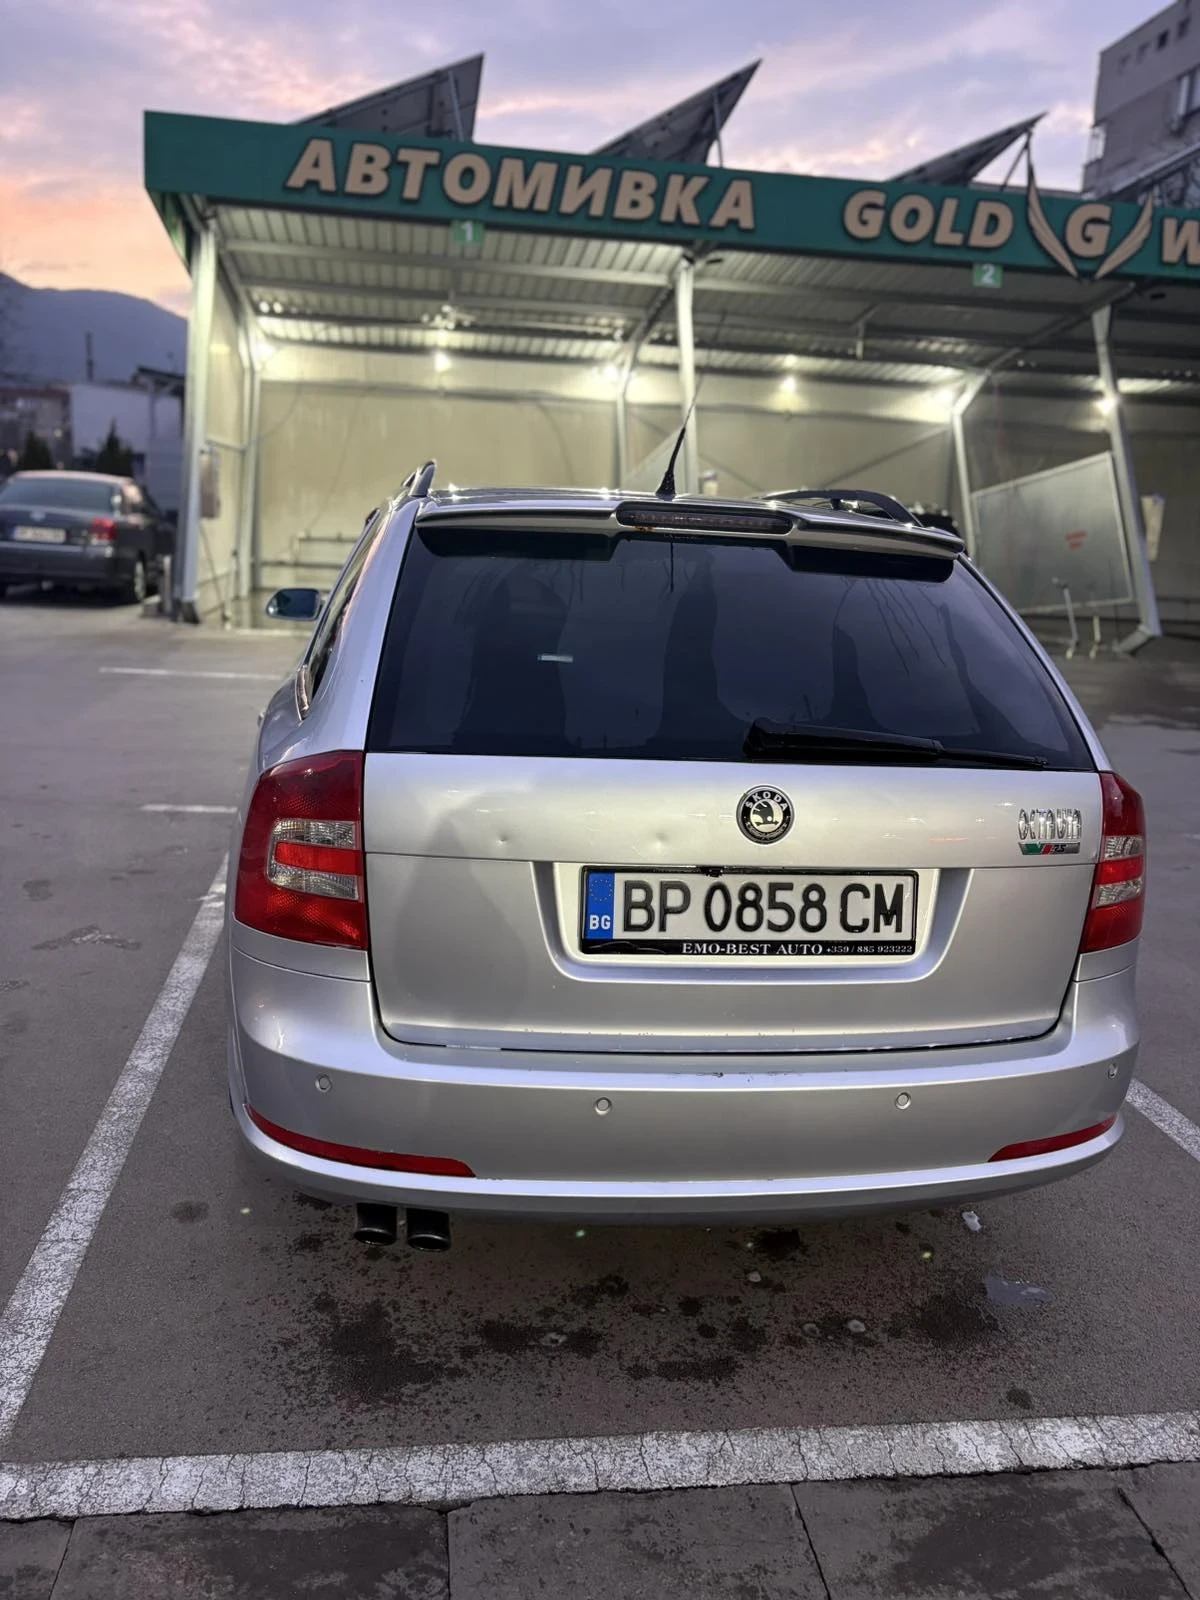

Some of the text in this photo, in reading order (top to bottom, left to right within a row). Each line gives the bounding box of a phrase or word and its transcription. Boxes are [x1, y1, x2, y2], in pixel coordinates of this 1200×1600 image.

[285, 138, 755, 230] АВТОМИВКА
[461, 221, 473, 242] 1
[843, 190, 1014, 248] GOLD
[1065, 203, 1112, 259] G
[981, 264, 994, 283] 2
[589, 914, 611, 930] BG
[622, 880, 904, 933] BP 0858 CM
[682, 942, 772, 955] EMO-BEST
[776, 943, 823, 955] AUTO
